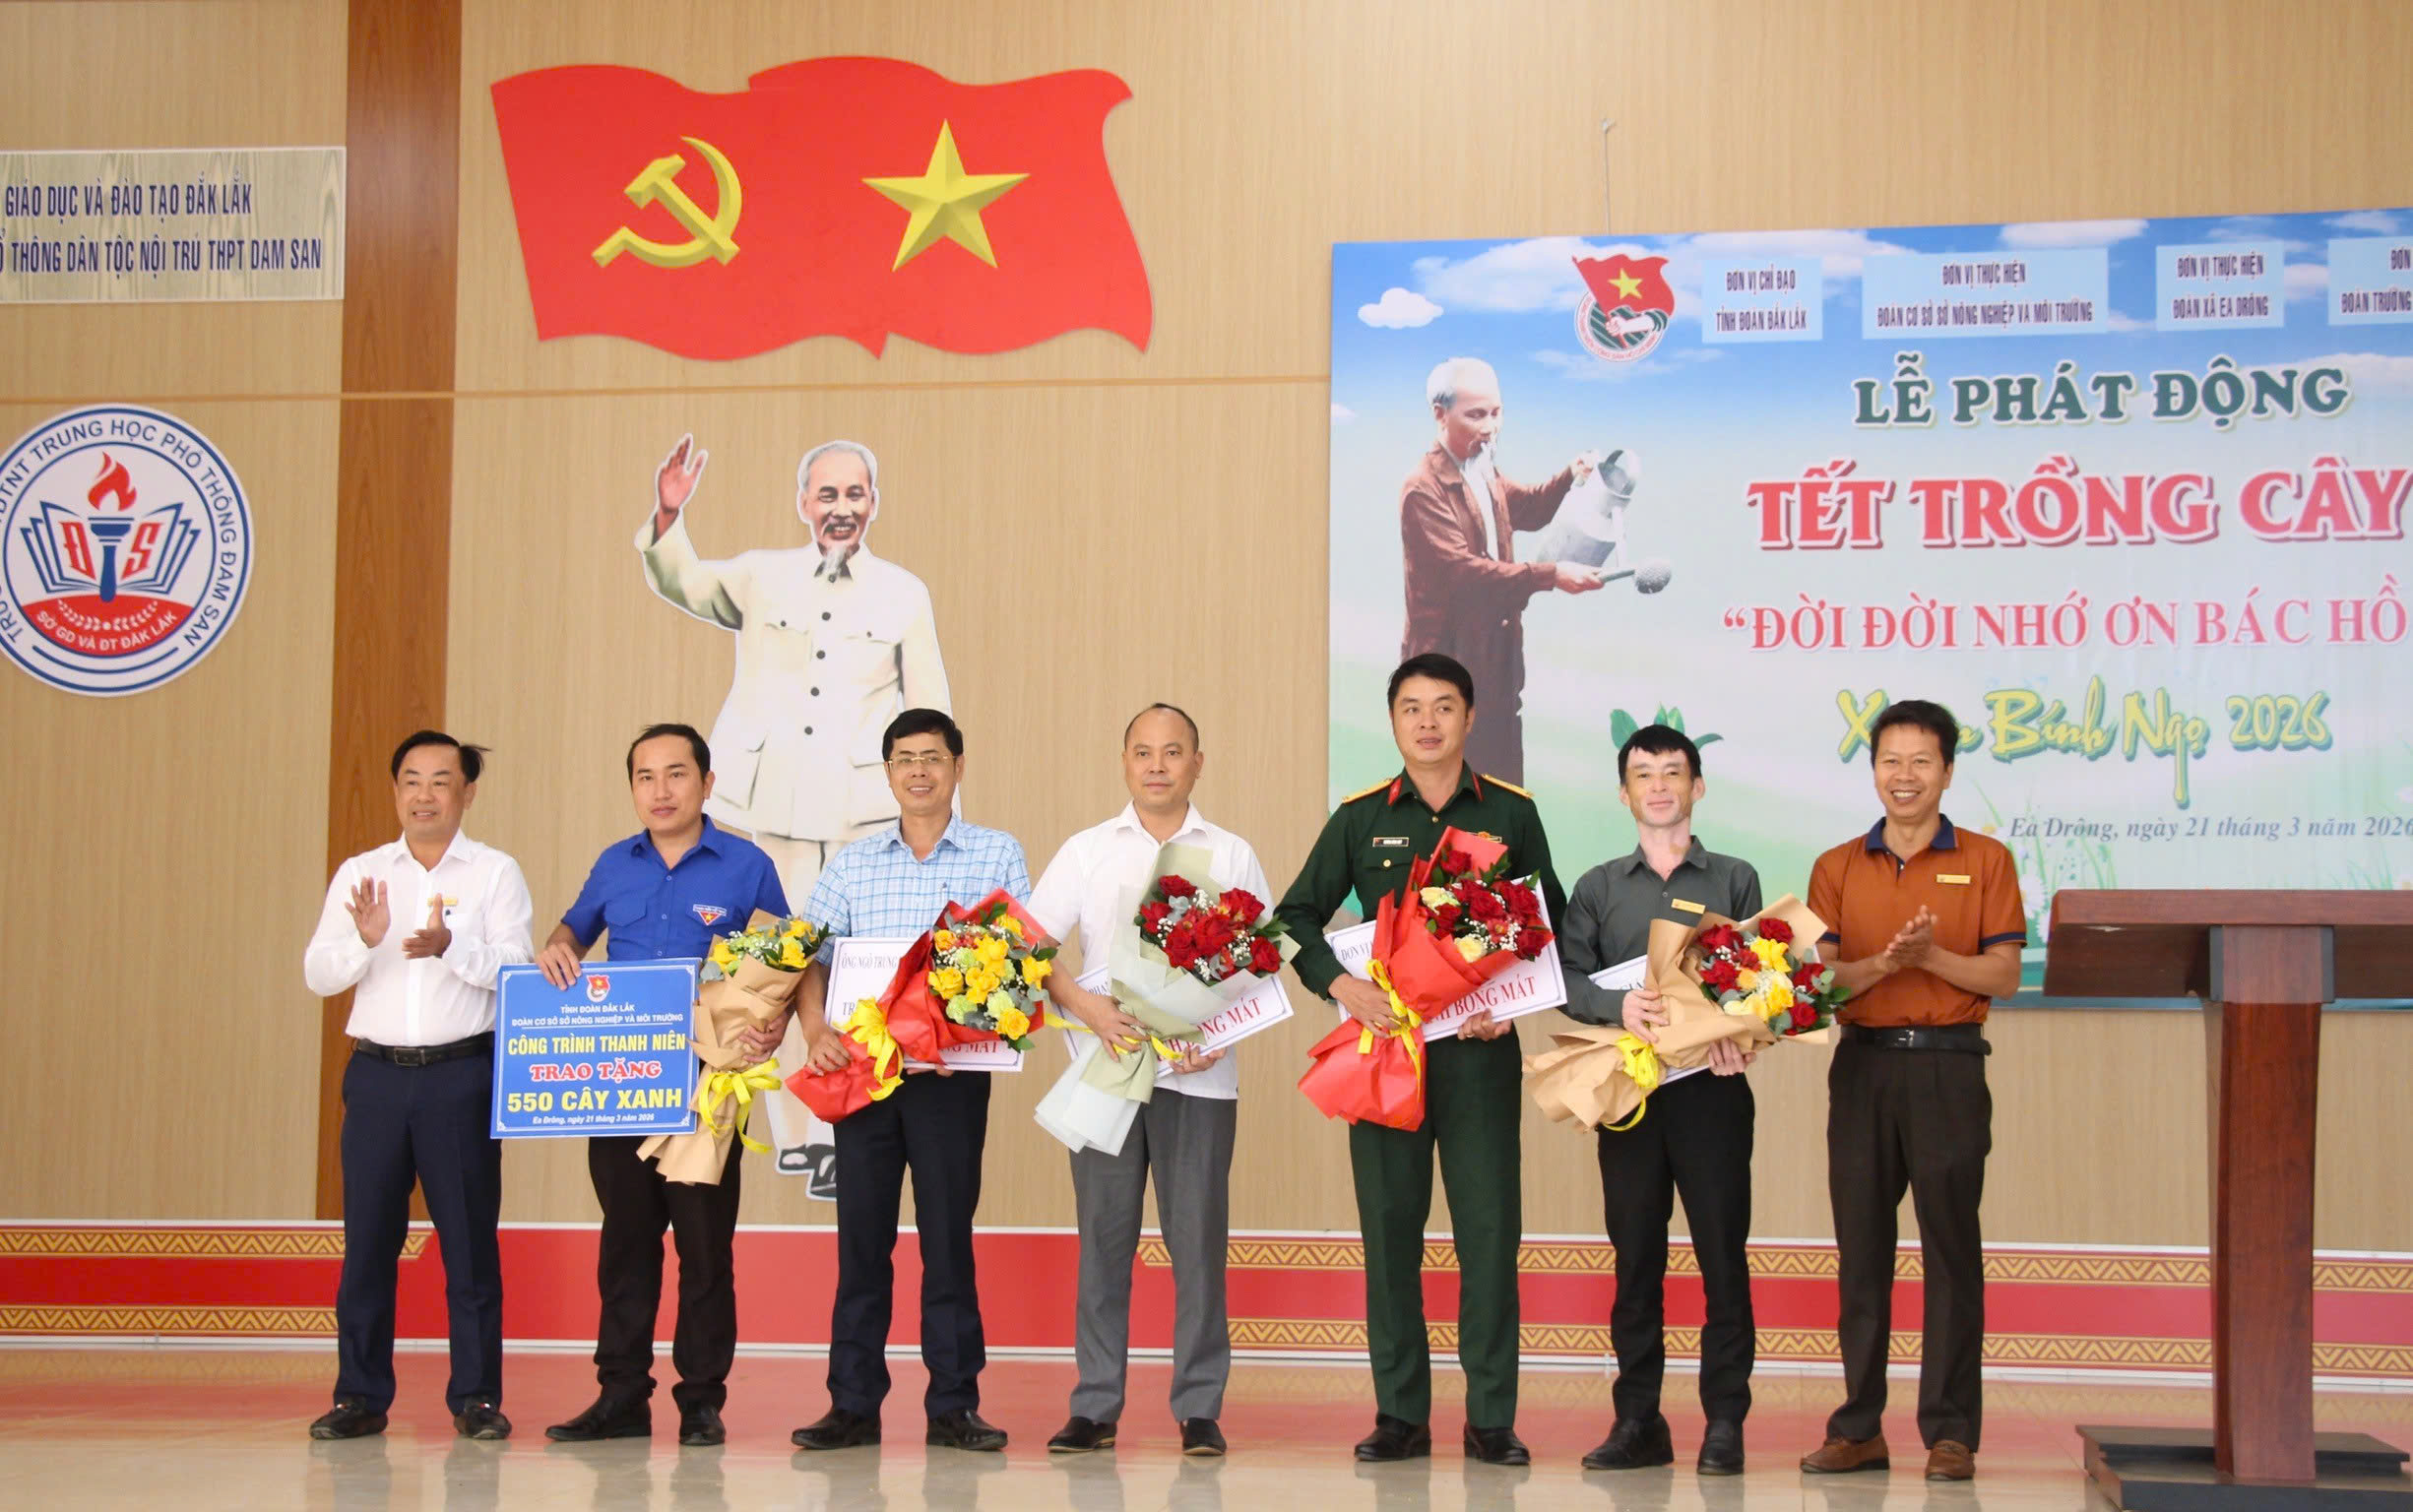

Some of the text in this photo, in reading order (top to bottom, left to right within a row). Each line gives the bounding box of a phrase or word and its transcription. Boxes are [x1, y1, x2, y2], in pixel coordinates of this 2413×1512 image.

[5, 171, 252, 224] GIÁO DỤC VÀ ĐÀO TẠO ĐẮK LẮK
[11, 235, 61, 273] THÔNG
[67, 234, 98, 273] DÂN
[104, 234, 134, 280] TỘC
[140, 233, 166, 280] NỘI
[172, 232, 201, 271] TRÚ
[208, 240, 245, 271] THPT
[251, 239, 285, 270] DAM
[290, 238, 321, 270] SAN
[2220, 296, 2233, 317] EA
[1853, 352, 2349, 427] LỄ PHÁT ĐỘNG
[30, 419, 103, 464] TRUNG
[110, 418, 158, 442] HỌC
[160, 430, 203, 470] PHỔ
[200, 469, 238, 544] THÔNG
[1746, 456, 2413, 549] TẾT TRỒNG CÂY
[183, 603, 221, 648] SAN
[1862, 593, 1959, 650] ĐỜI
[1973, 590, 2089, 650] NHỚ
[2104, 594, 2180, 648] ƠN
[2194, 586, 2312, 646] BÁC
[2324, 574, 2408, 643] HỒ
[55, 626, 76, 644] GD
[78, 633, 96, 650] VÀ
[1836, 688, 1982, 763] Xn
[2226, 690, 2333, 754] 2026
[2009, 817, 2038, 837] Ea
[2127, 817, 2179, 842] ngày
[2186, 817, 2211, 837] 21
[2217, 816, 2280, 843] tháng
[2287, 817, 2301, 837] 3
[2307, 818, 2357, 837] năm
[1500, 974, 1535, 1002] MÁT
[1227, 997, 1261, 1025] MÁT
[507, 1030, 686, 1055] CÔNG TRÌNH THANH NIÊN
[530, 1057, 663, 1084] TRAO TẶNG
[507, 1086, 682, 1112] 550 CÂY XANH
